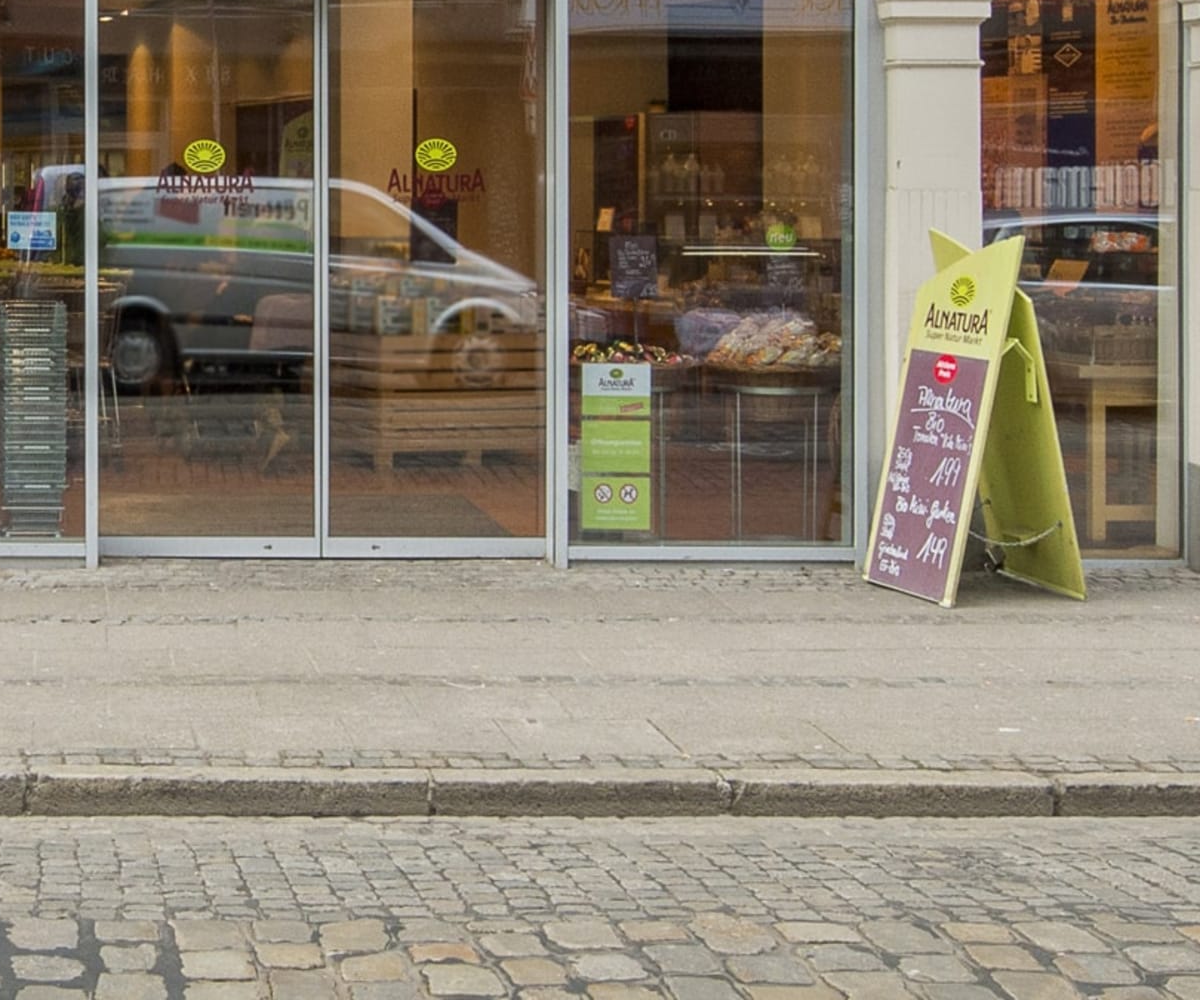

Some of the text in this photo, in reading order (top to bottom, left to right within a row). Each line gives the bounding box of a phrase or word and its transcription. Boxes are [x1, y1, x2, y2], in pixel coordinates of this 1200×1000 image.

[156, 168, 254, 194] ALNATURA
[387, 168, 486, 193] ALNATURA
[924, 302, 988, 336] ALNATURA
